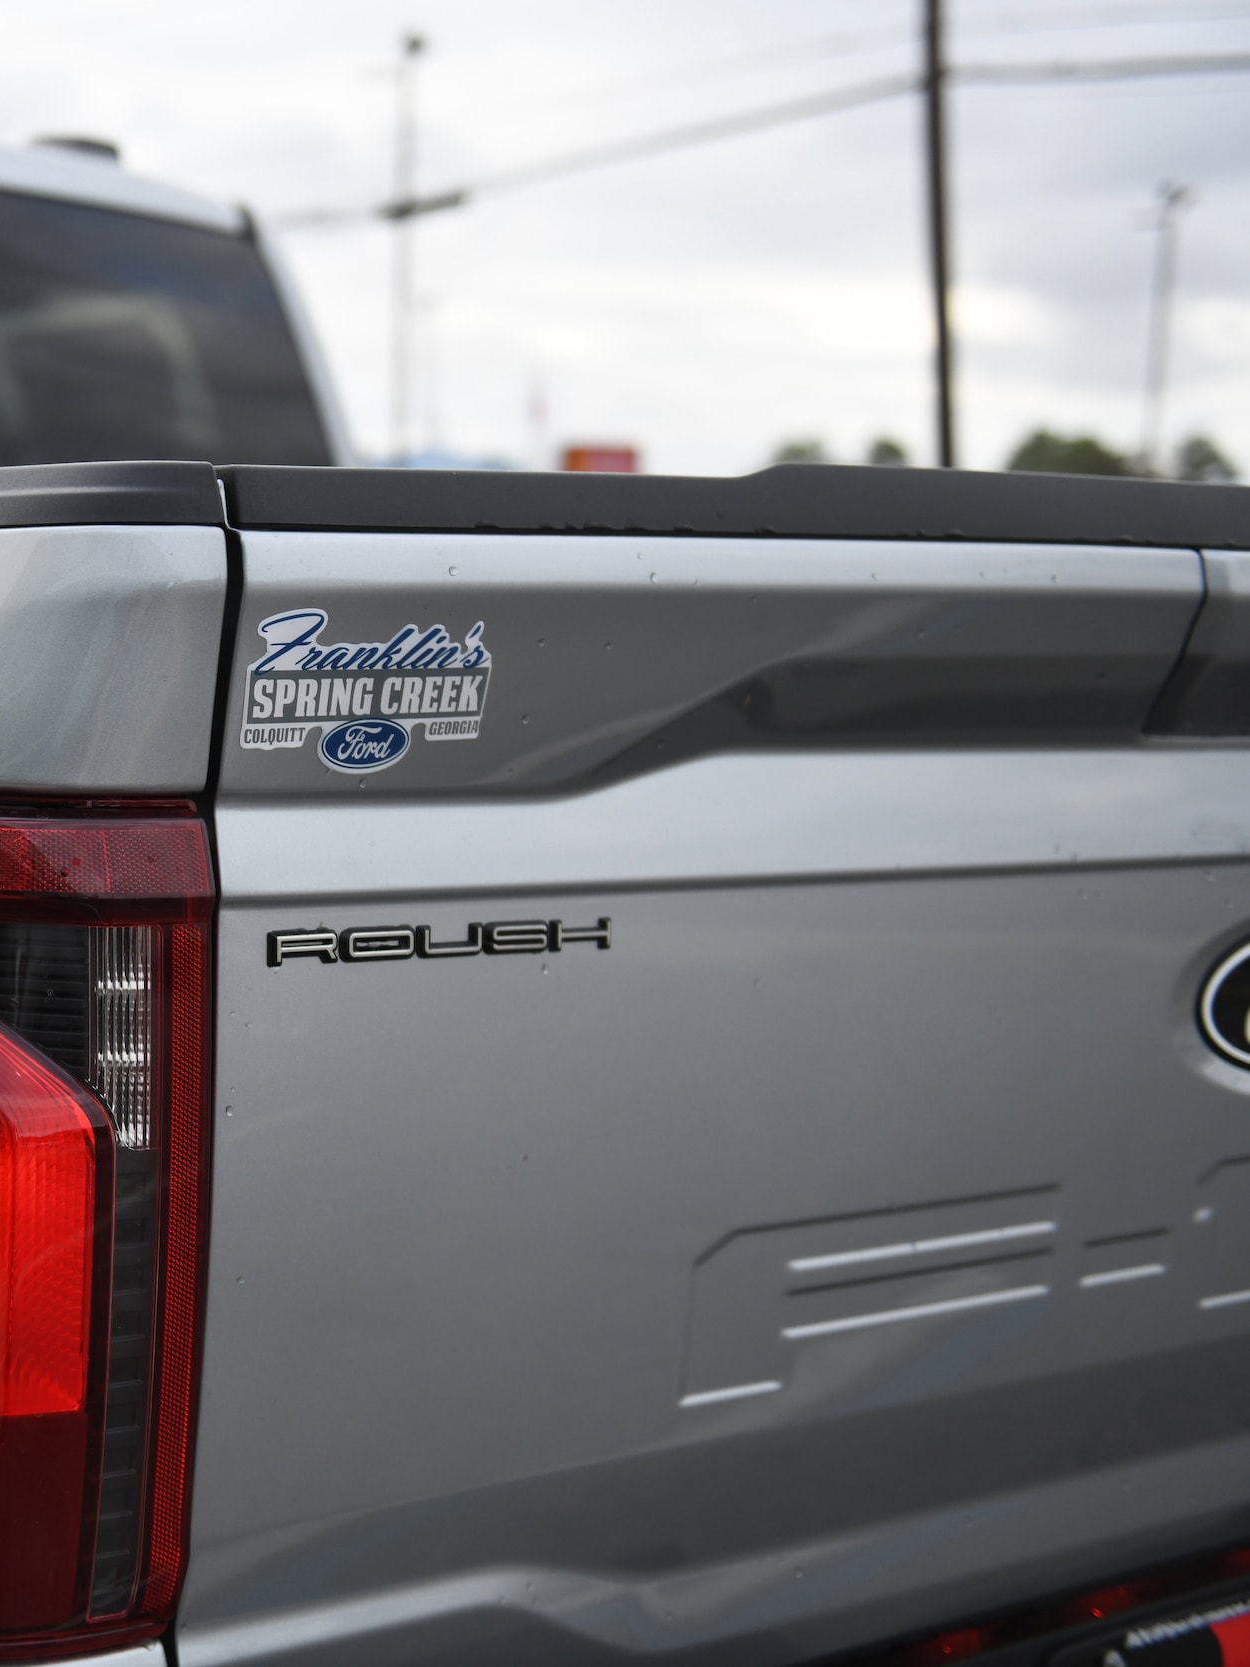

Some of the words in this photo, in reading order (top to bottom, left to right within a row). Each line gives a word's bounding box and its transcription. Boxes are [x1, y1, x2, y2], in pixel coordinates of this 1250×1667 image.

[254, 612, 489, 676] Franklin's
[252, 678, 375, 719] SPRING
[380, 675, 483, 714] CREEK
[243, 727, 306, 744] COLQUITT
[337, 726, 391, 760] Ford
[428, 720, 479, 736] GEORGIA
[266, 917, 611, 967] ROUSH
